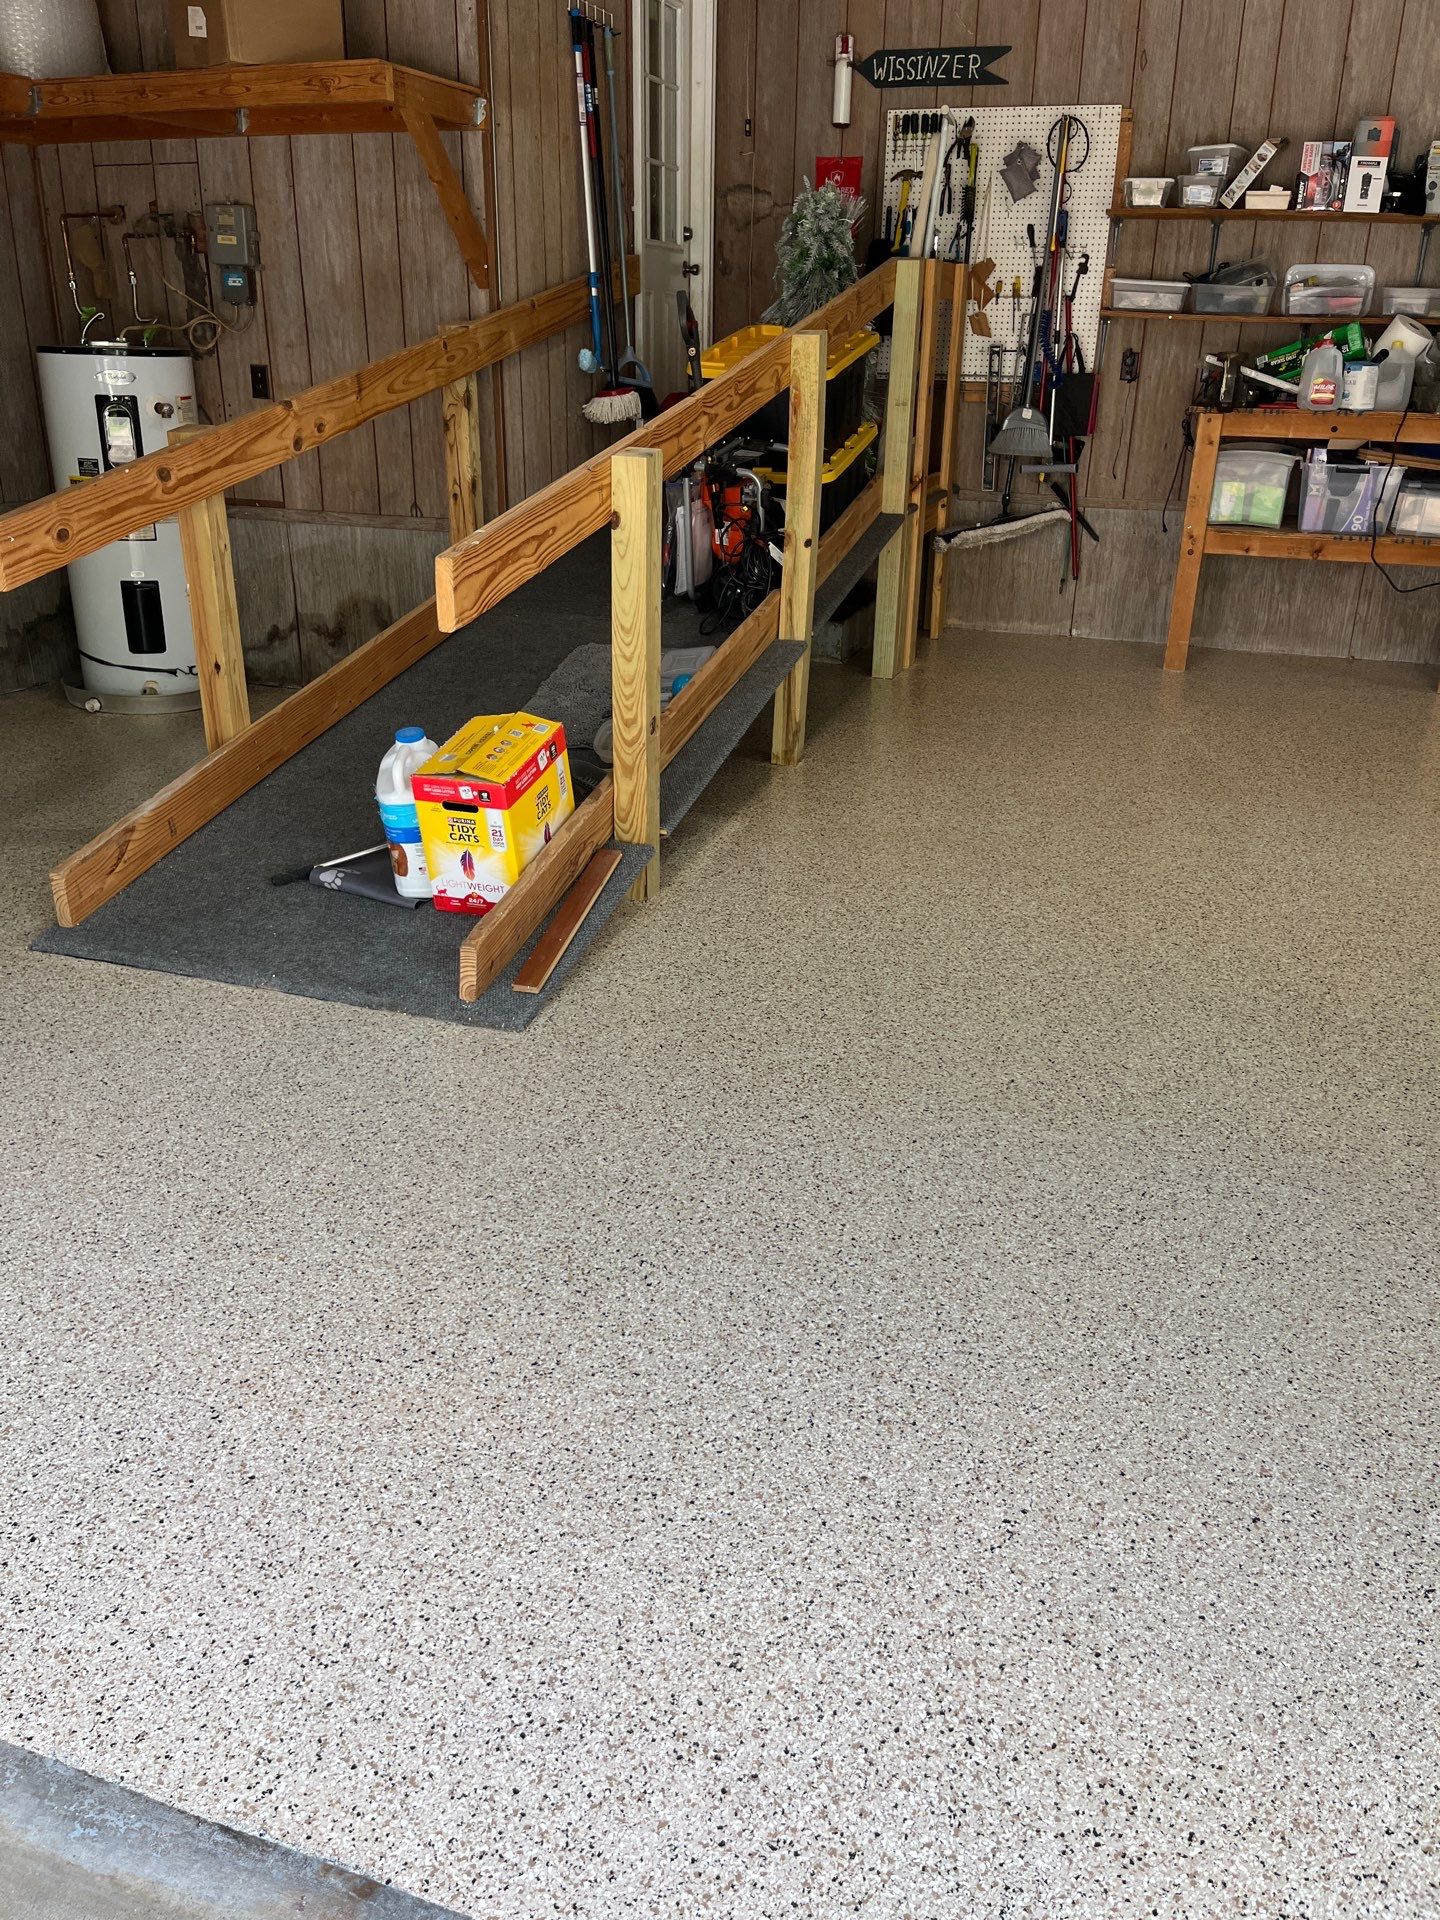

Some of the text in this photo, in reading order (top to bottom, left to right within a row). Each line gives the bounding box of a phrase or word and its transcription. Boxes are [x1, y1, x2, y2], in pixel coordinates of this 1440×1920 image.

[873, 54, 981, 82] WISSINZER
[1270, 357, 1286, 366] SUGAR
[1351, 515, 1364, 531] 90
[536, 792, 549, 811] TIDY
[537, 800, 552, 820] CATS
[448, 824, 477, 835] TIDY
[491, 829, 503, 837] 21
[449, 833, 480, 843] CATS
[442, 880, 505, 894] LIGHTWEIGHT
